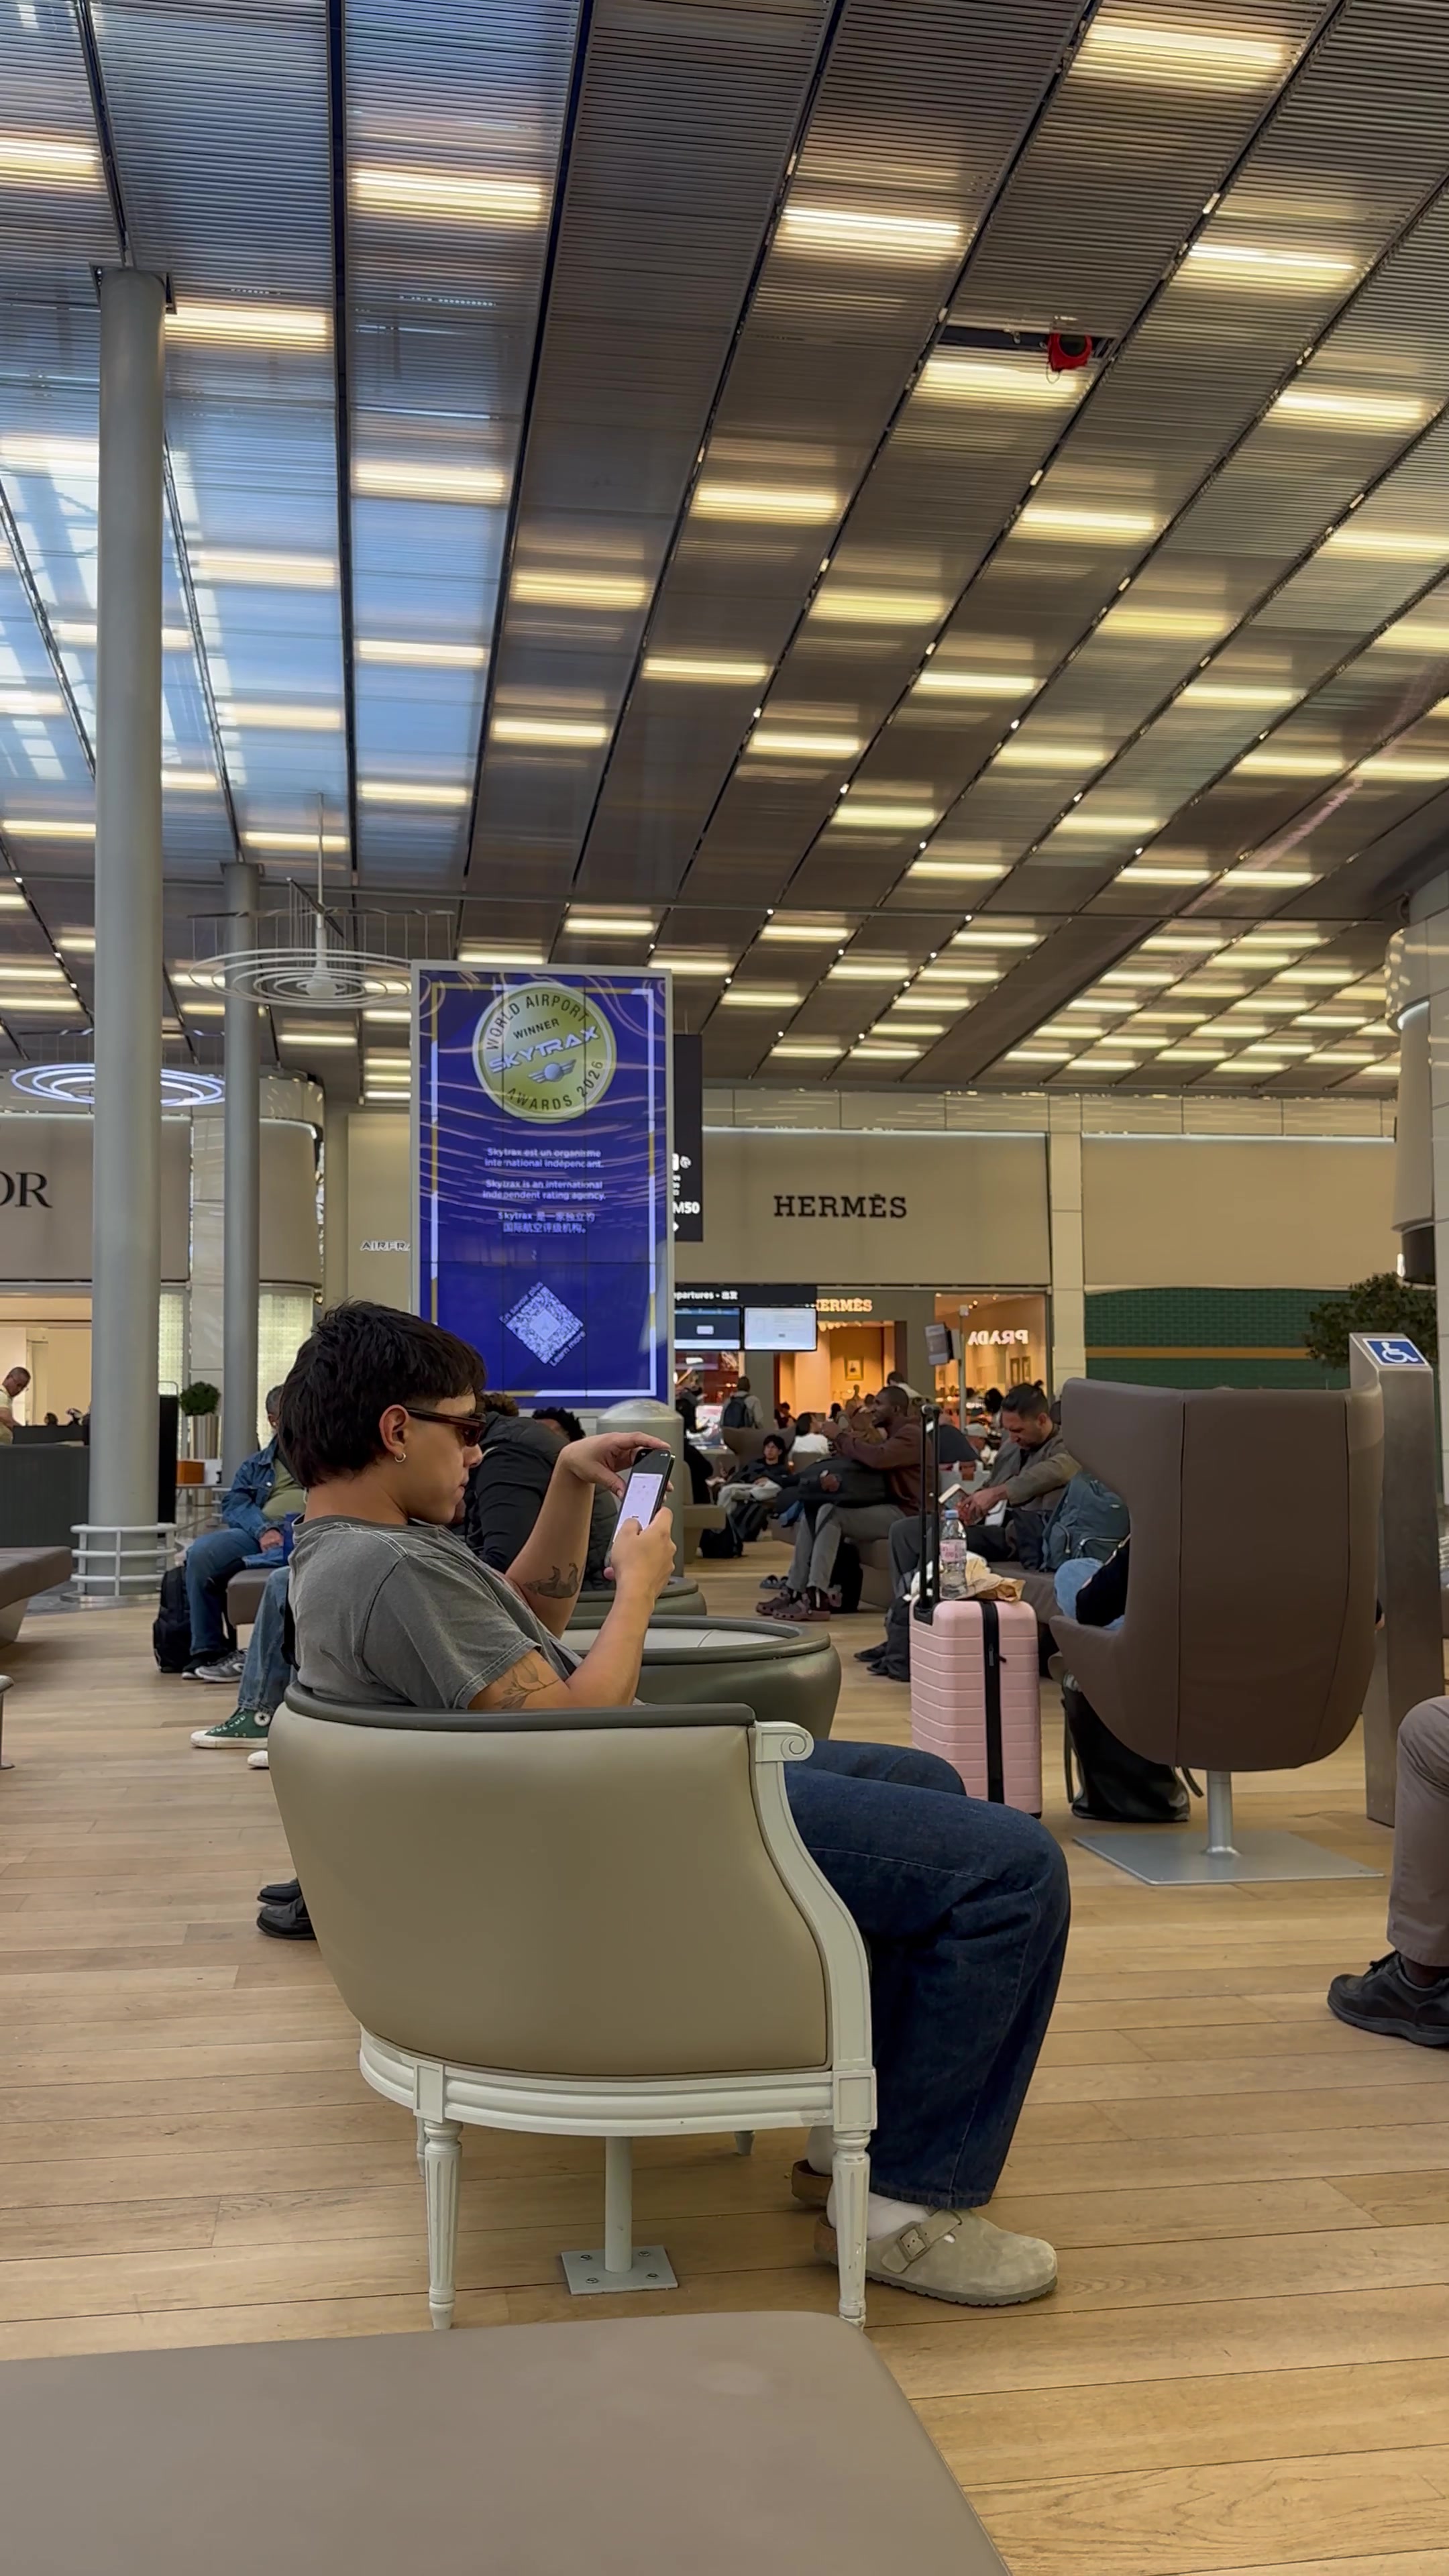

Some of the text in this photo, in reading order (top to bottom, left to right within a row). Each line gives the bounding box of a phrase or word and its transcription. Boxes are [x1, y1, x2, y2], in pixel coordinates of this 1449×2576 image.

[486, 994, 590, 1051] WORLD AIRPORT
[513, 1018, 560, 1039] WINNER
[488, 1026, 600, 1073] SKYTRAX
[507, 1061, 603, 1111] AWARDS 2026
[487, 1147, 521, 1158] Skytrax
[523, 1148, 537, 1157] est
[532, 1181, 543, 1189] an
[542, 1191, 570, 1201] rating
[773, 1193, 907, 1218] HERMÈS
[498, 1212, 533, 1221] Skytrax
